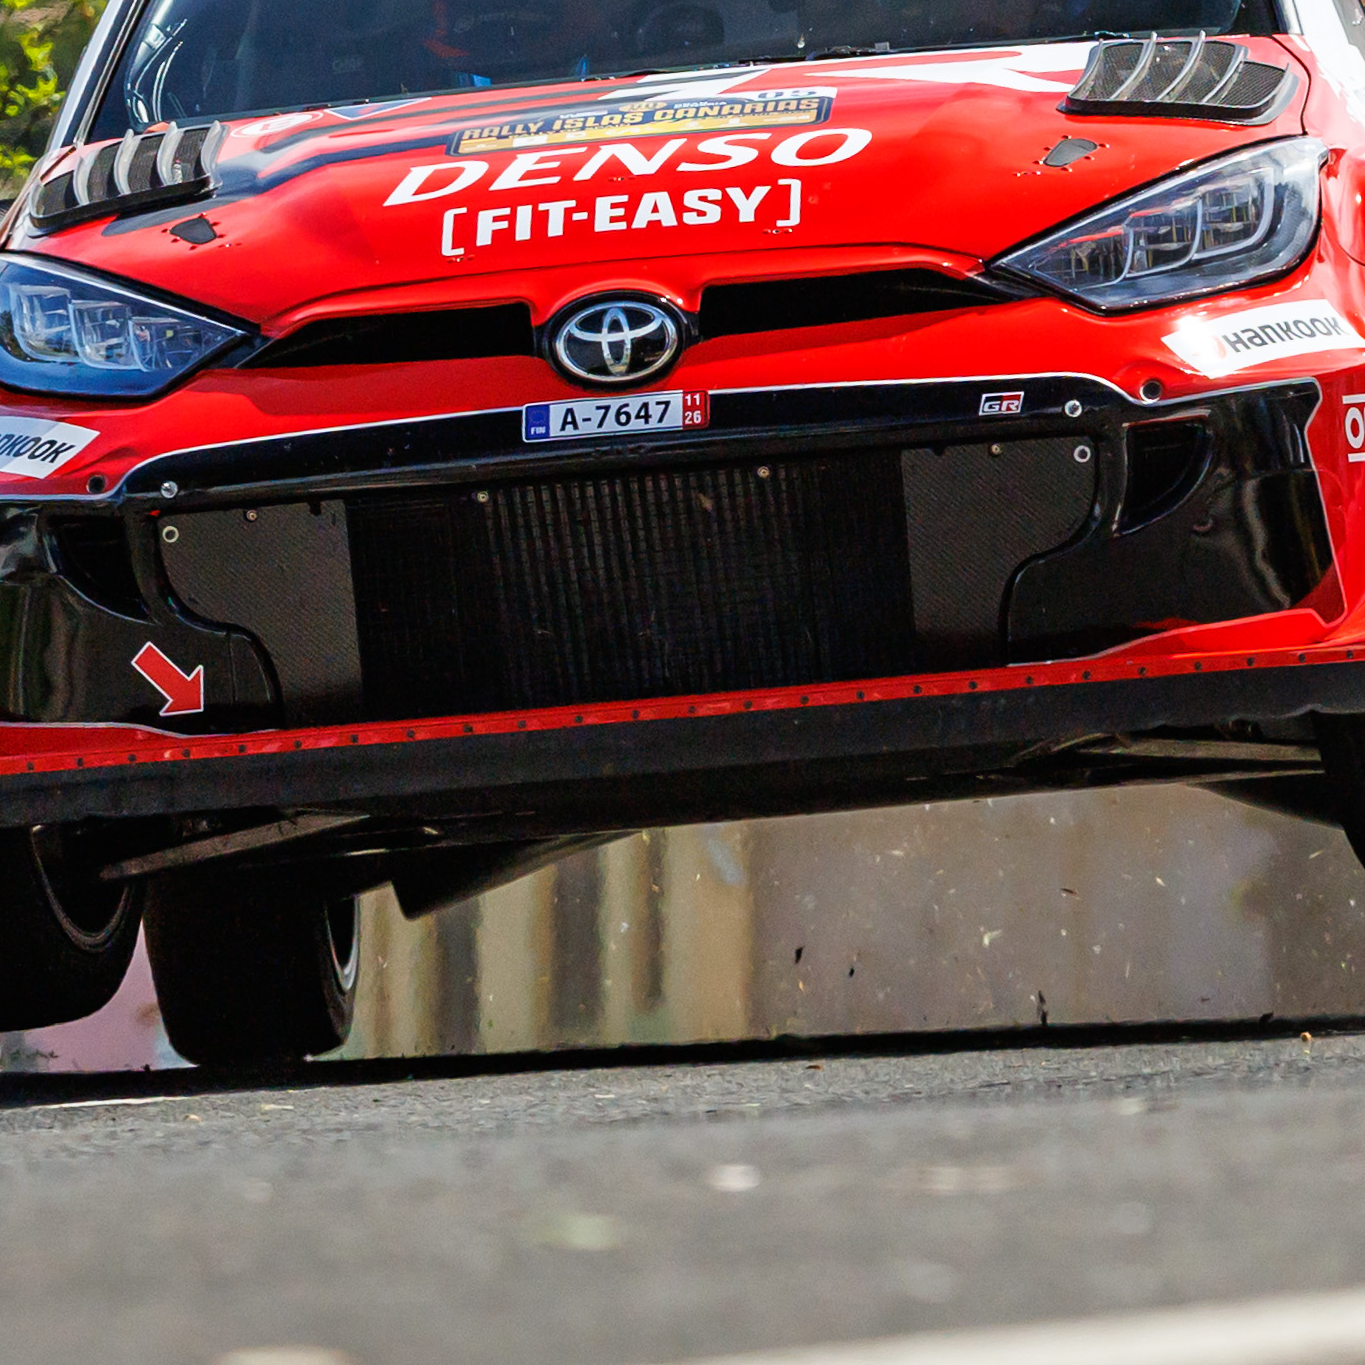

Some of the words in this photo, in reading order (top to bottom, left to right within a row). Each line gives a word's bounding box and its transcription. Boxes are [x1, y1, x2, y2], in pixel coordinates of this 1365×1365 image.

[462, 120, 545, 140] RALLY
[552, 111, 644, 132] ISLAS
[653, 97, 820, 122] CANARIAS
[383, 129, 873, 207] DENSO
[684, 393, 701, 406] 11
[559, 400, 672, 432] A-7647
[684, 410, 702, 425] 26
